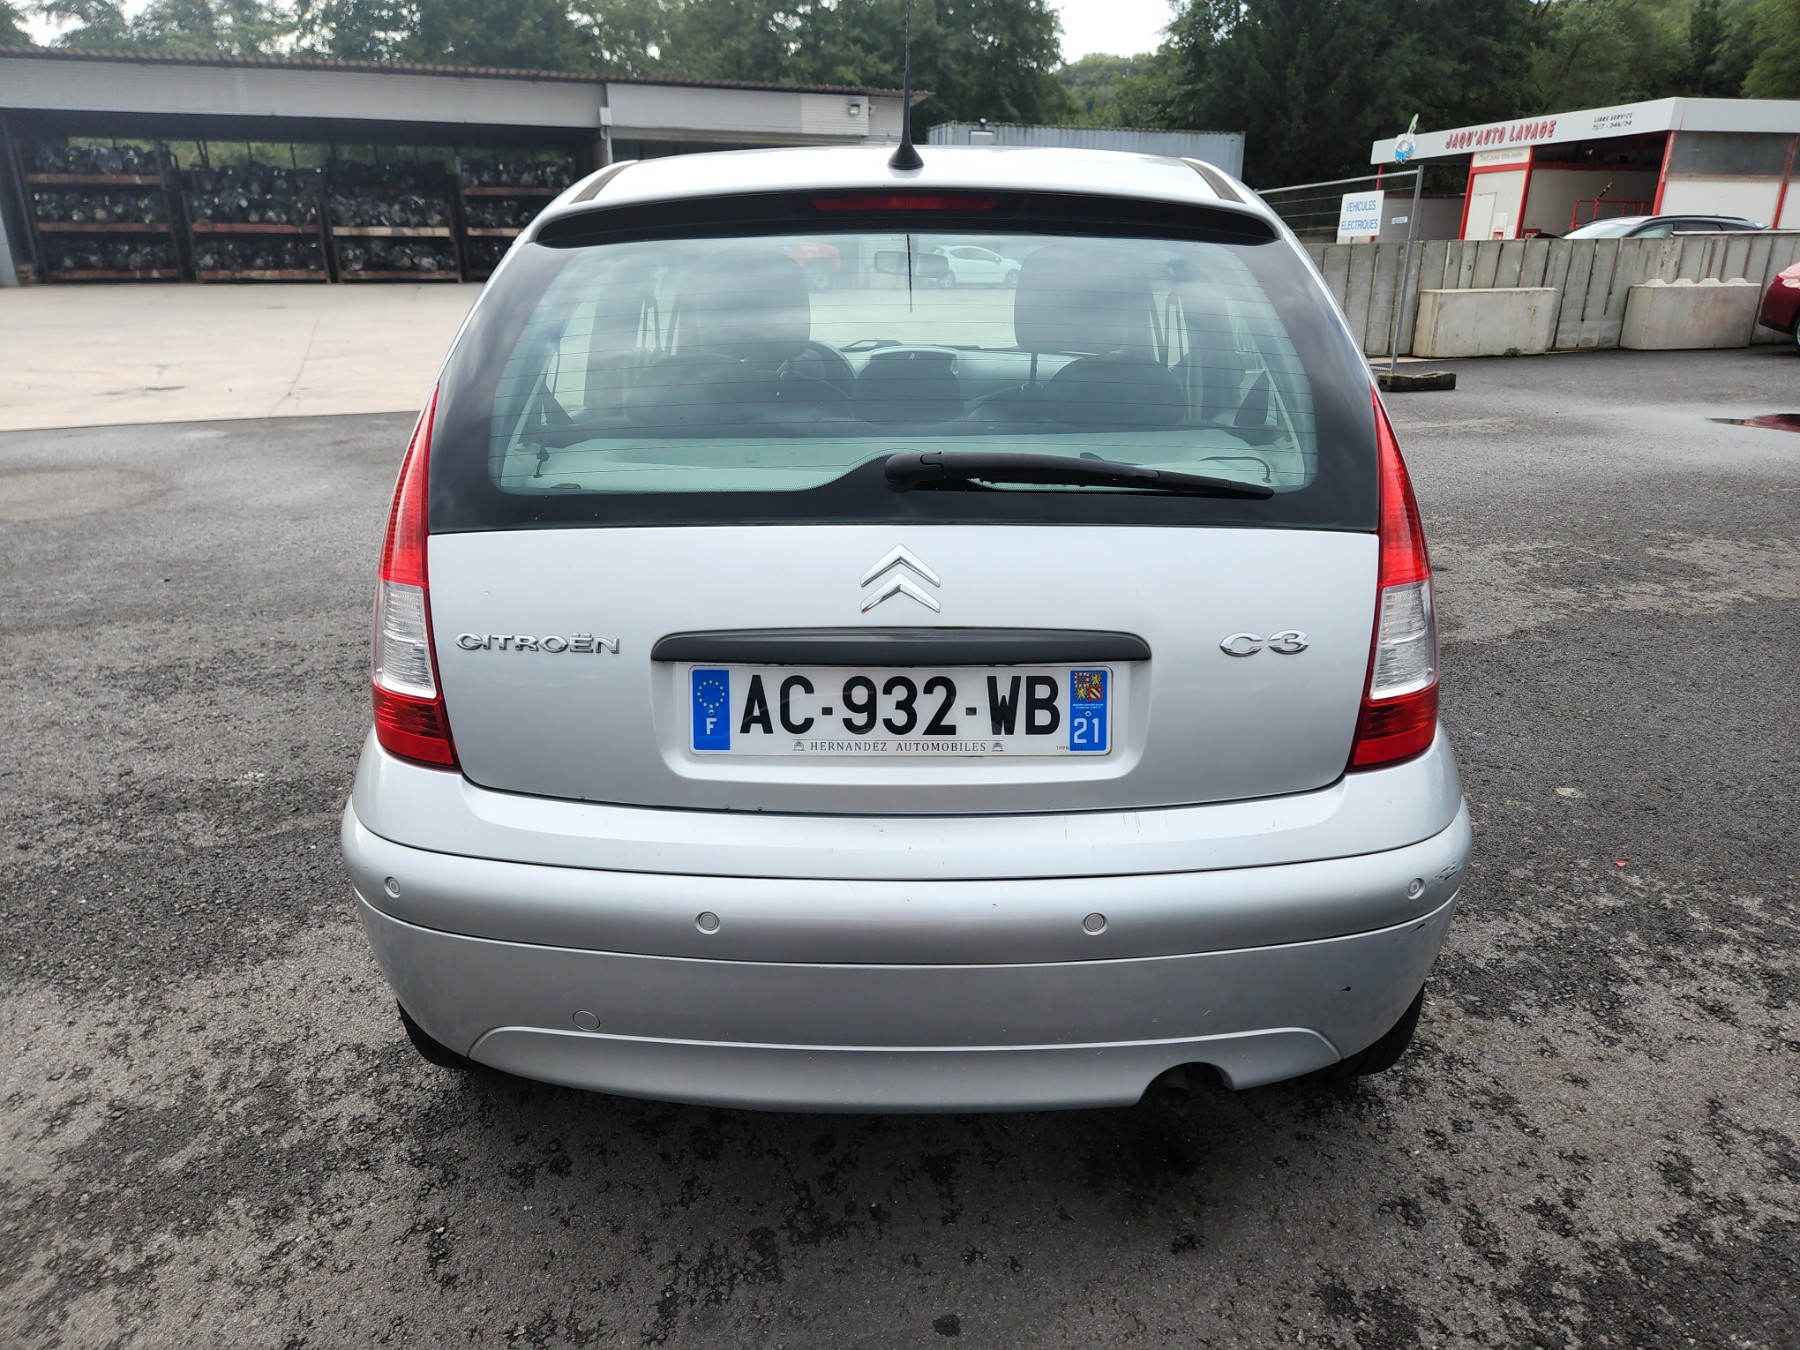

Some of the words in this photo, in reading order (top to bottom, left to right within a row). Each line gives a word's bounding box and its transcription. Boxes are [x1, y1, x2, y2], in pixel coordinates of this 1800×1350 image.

[1445, 126, 1506, 150] JAQU'AUTO
[1509, 119, 1557, 143] LAVAGE
[454, 632, 620, 655] CITROËN
[1219, 628, 1310, 658] C3
[739, 674, 1061, 736] AC-932-WB
[705, 717, 718, 735] F
[1073, 717, 1100, 744] 21
[810, 741, 888, 752] HERNANDEZ
[895, 742, 987, 752] AUTOMOBILES
